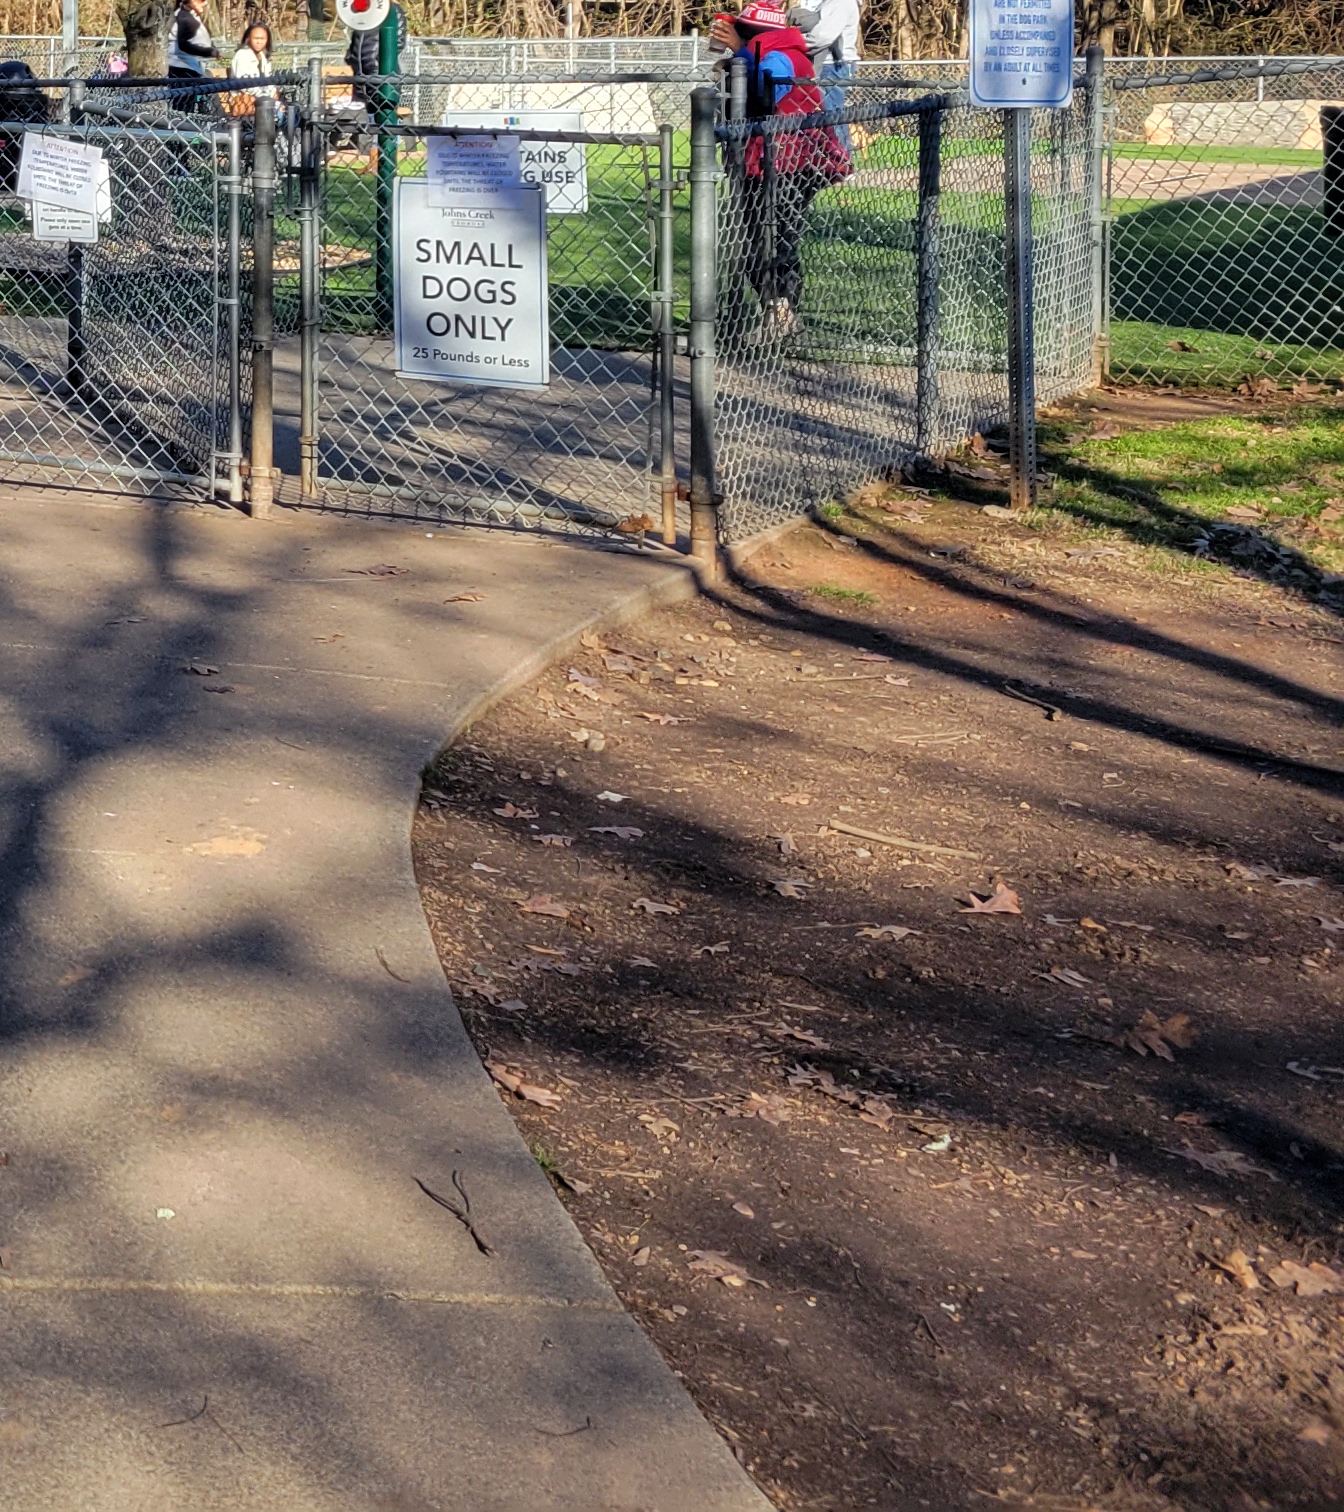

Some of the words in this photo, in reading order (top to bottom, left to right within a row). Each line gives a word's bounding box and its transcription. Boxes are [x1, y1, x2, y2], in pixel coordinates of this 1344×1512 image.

[542, 171, 574, 183] USE
[442, 208, 466, 218] Johns
[468, 210, 495, 219] Creek
[415, 239, 523, 268] SMALL
[422, 276, 517, 305] DOGS
[426, 312, 513, 341] ONLY
[413, 347, 429, 358] 25
[434, 349, 480, 364] Pounds
[484, 356, 498, 364] or
[502, 356, 530, 368] Less
